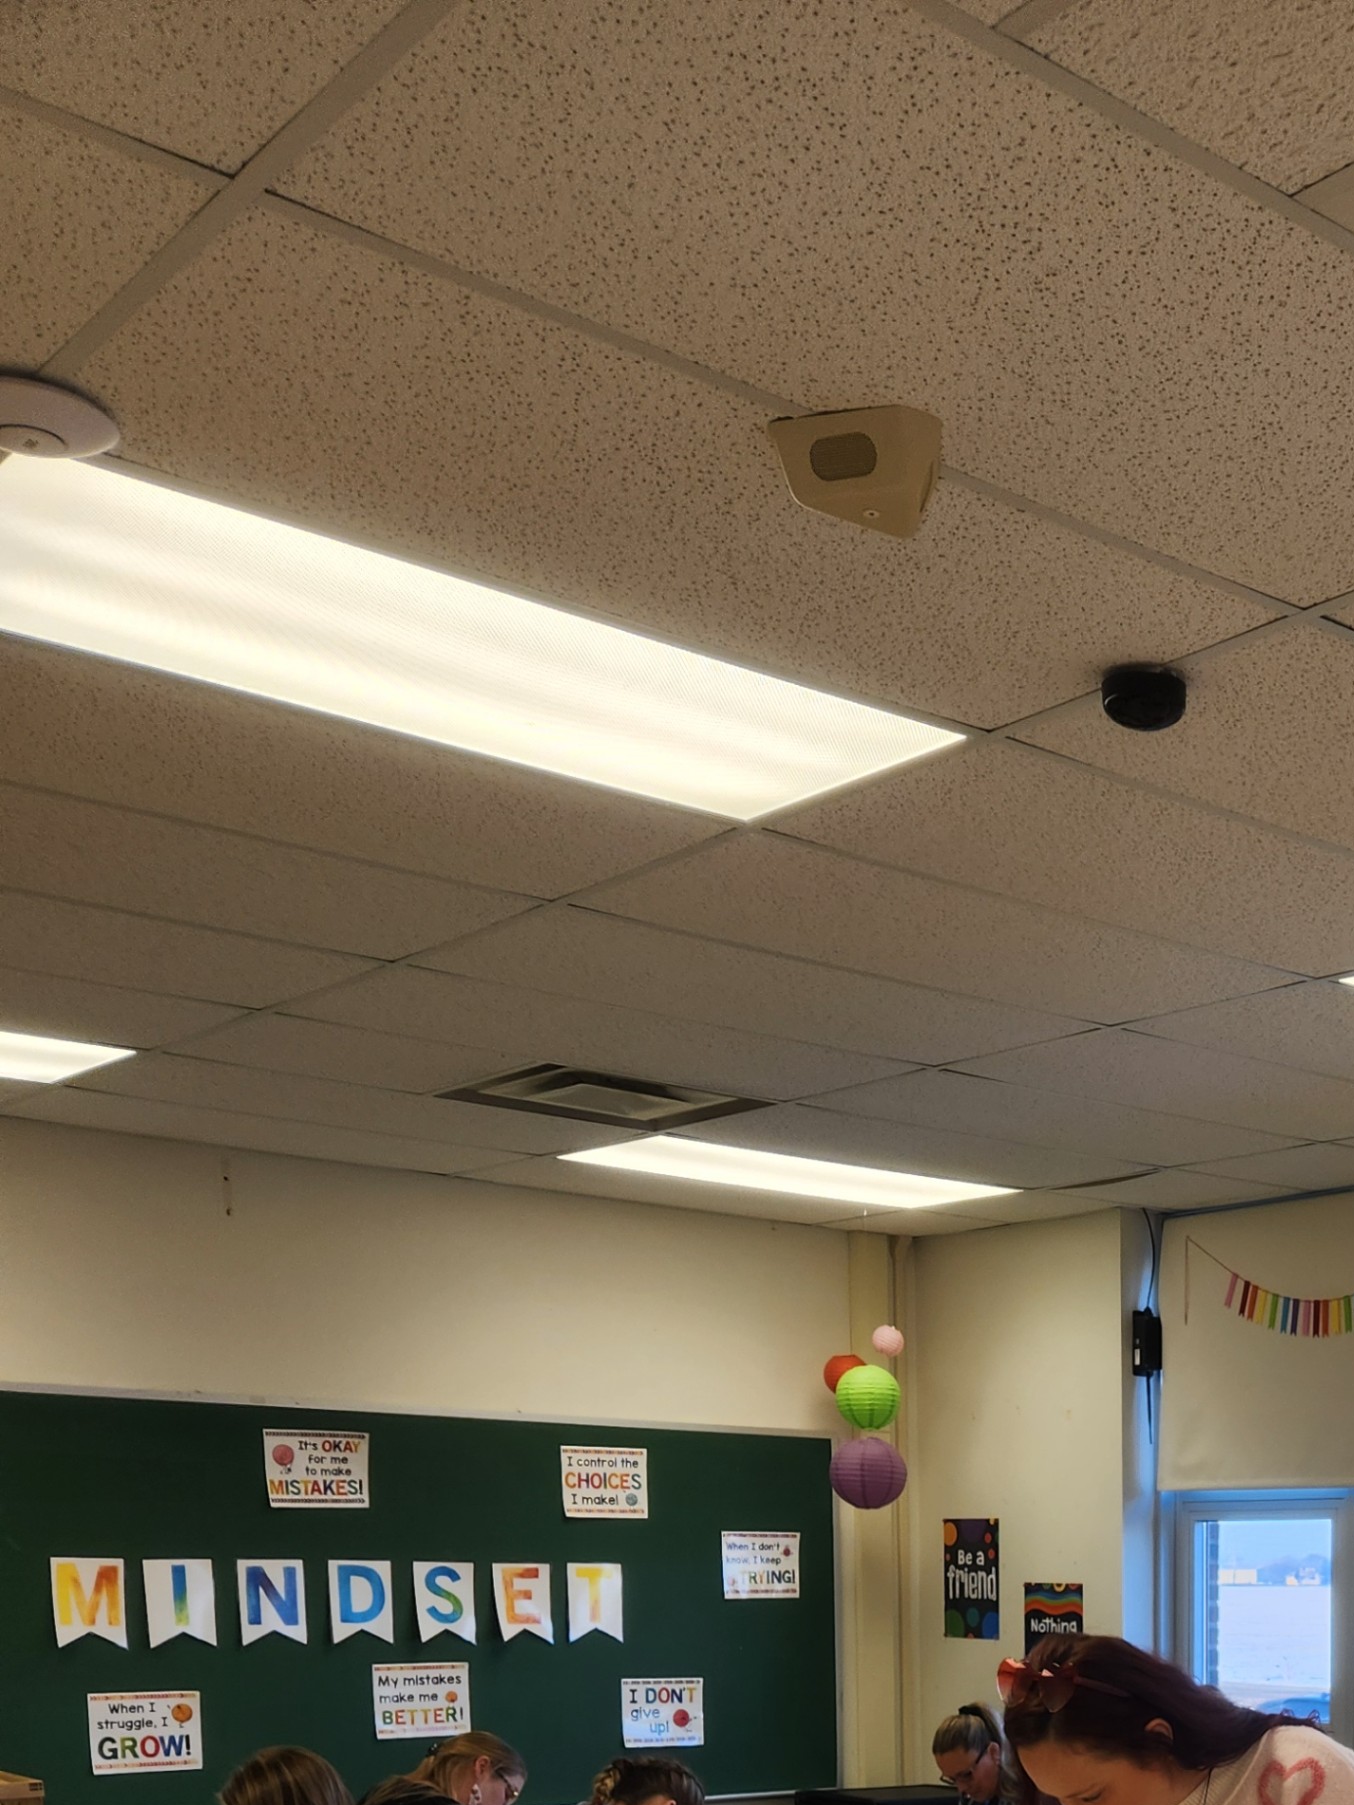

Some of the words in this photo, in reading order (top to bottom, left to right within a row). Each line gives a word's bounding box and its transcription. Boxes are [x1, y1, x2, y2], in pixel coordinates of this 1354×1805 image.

[298, 1440, 318, 1451] It's
[321, 1439, 361, 1453] OKAY
[308, 1454, 326, 1464] for
[330, 1456, 349, 1465] me
[567, 1456, 573, 1467] I
[576, 1457, 618, 1468] control
[621, 1457, 639, 1468] the
[305, 1466, 317, 1476] to
[320, 1467, 352, 1476] make
[269, 1479, 363, 1496] MISTAKES!
[564, 1472, 642, 1490] CHOICES
[571, 1493, 578, 1505] I
[581, 1493, 619, 1506] make!
[726, 1542, 749, 1551] When
[751, 1542, 756, 1551] I
[758, 1542, 780, 1551] don't
[753, 1556, 758, 1565] I
[760, 1555, 782, 1566] keep
[957, 1549, 973, 1566] Be
[976, 1550, 985, 1566] a
[740, 1569, 796, 1585] TRYING!
[946, 1564, 997, 1601] friend
[56, 1563, 608, 1627] MINDSET
[1030, 1616, 1078, 1633] Nothing
[378, 1675, 399, 1689] My
[403, 1673, 462, 1686] mistakes
[380, 1692, 415, 1703] make
[419, 1693, 438, 1702] me
[629, 1688, 638, 1704] I
[645, 1687, 697, 1704] DON'T
[108, 1703, 145, 1714] When
[149, 1702, 156, 1713] I
[382, 1706, 464, 1725] BETTER!
[630, 1706, 660, 1721] give
[97, 1717, 157, 1731] struggle,
[161, 1716, 168, 1727] I
[649, 1720, 669, 1736] up!
[97, 1734, 192, 1760] GROW!
